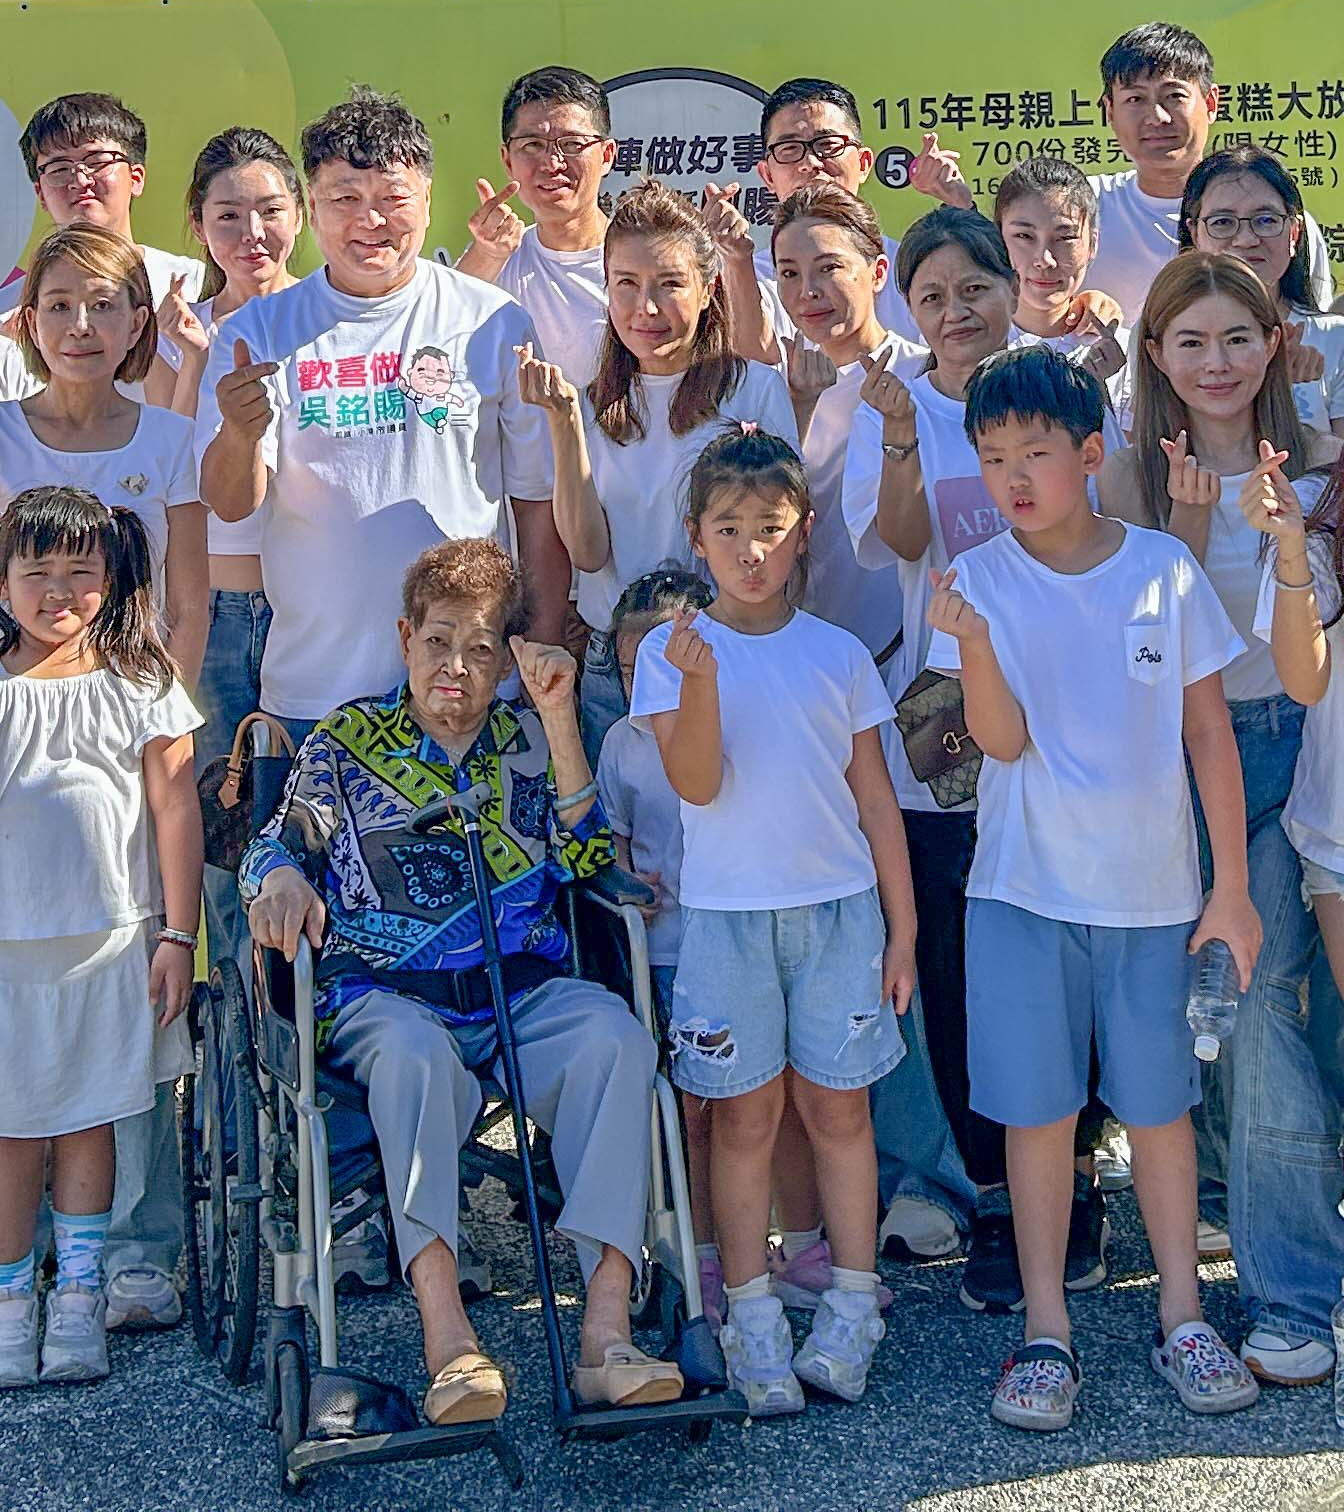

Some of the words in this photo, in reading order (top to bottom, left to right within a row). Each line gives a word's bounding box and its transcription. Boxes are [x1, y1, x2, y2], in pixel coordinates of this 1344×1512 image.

[297, 351, 404, 392] 歡喜做
[298, 388, 407, 431] 吳銘賜
